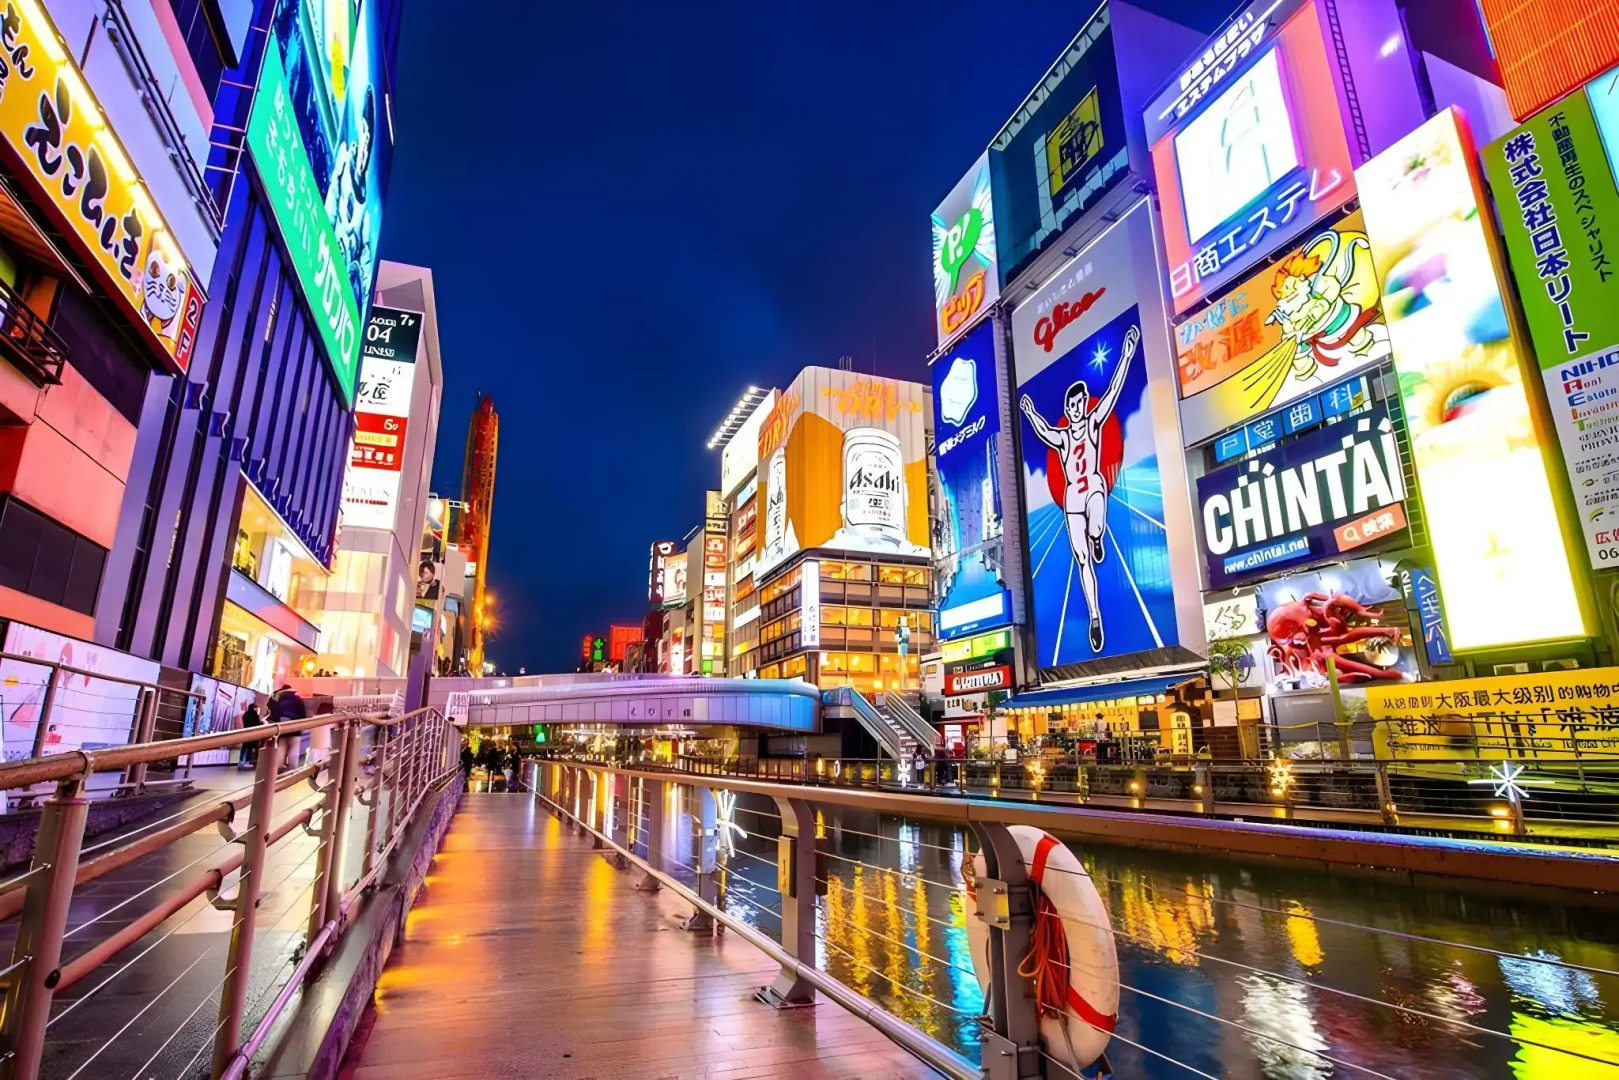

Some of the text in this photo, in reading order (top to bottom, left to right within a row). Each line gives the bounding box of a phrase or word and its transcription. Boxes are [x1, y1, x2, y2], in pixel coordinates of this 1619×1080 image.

[1503, 131, 1589, 354] 株式会社日本リート
[850, 467, 899, 494] Asahi
[1203, 417, 1405, 555] CHINTAI
